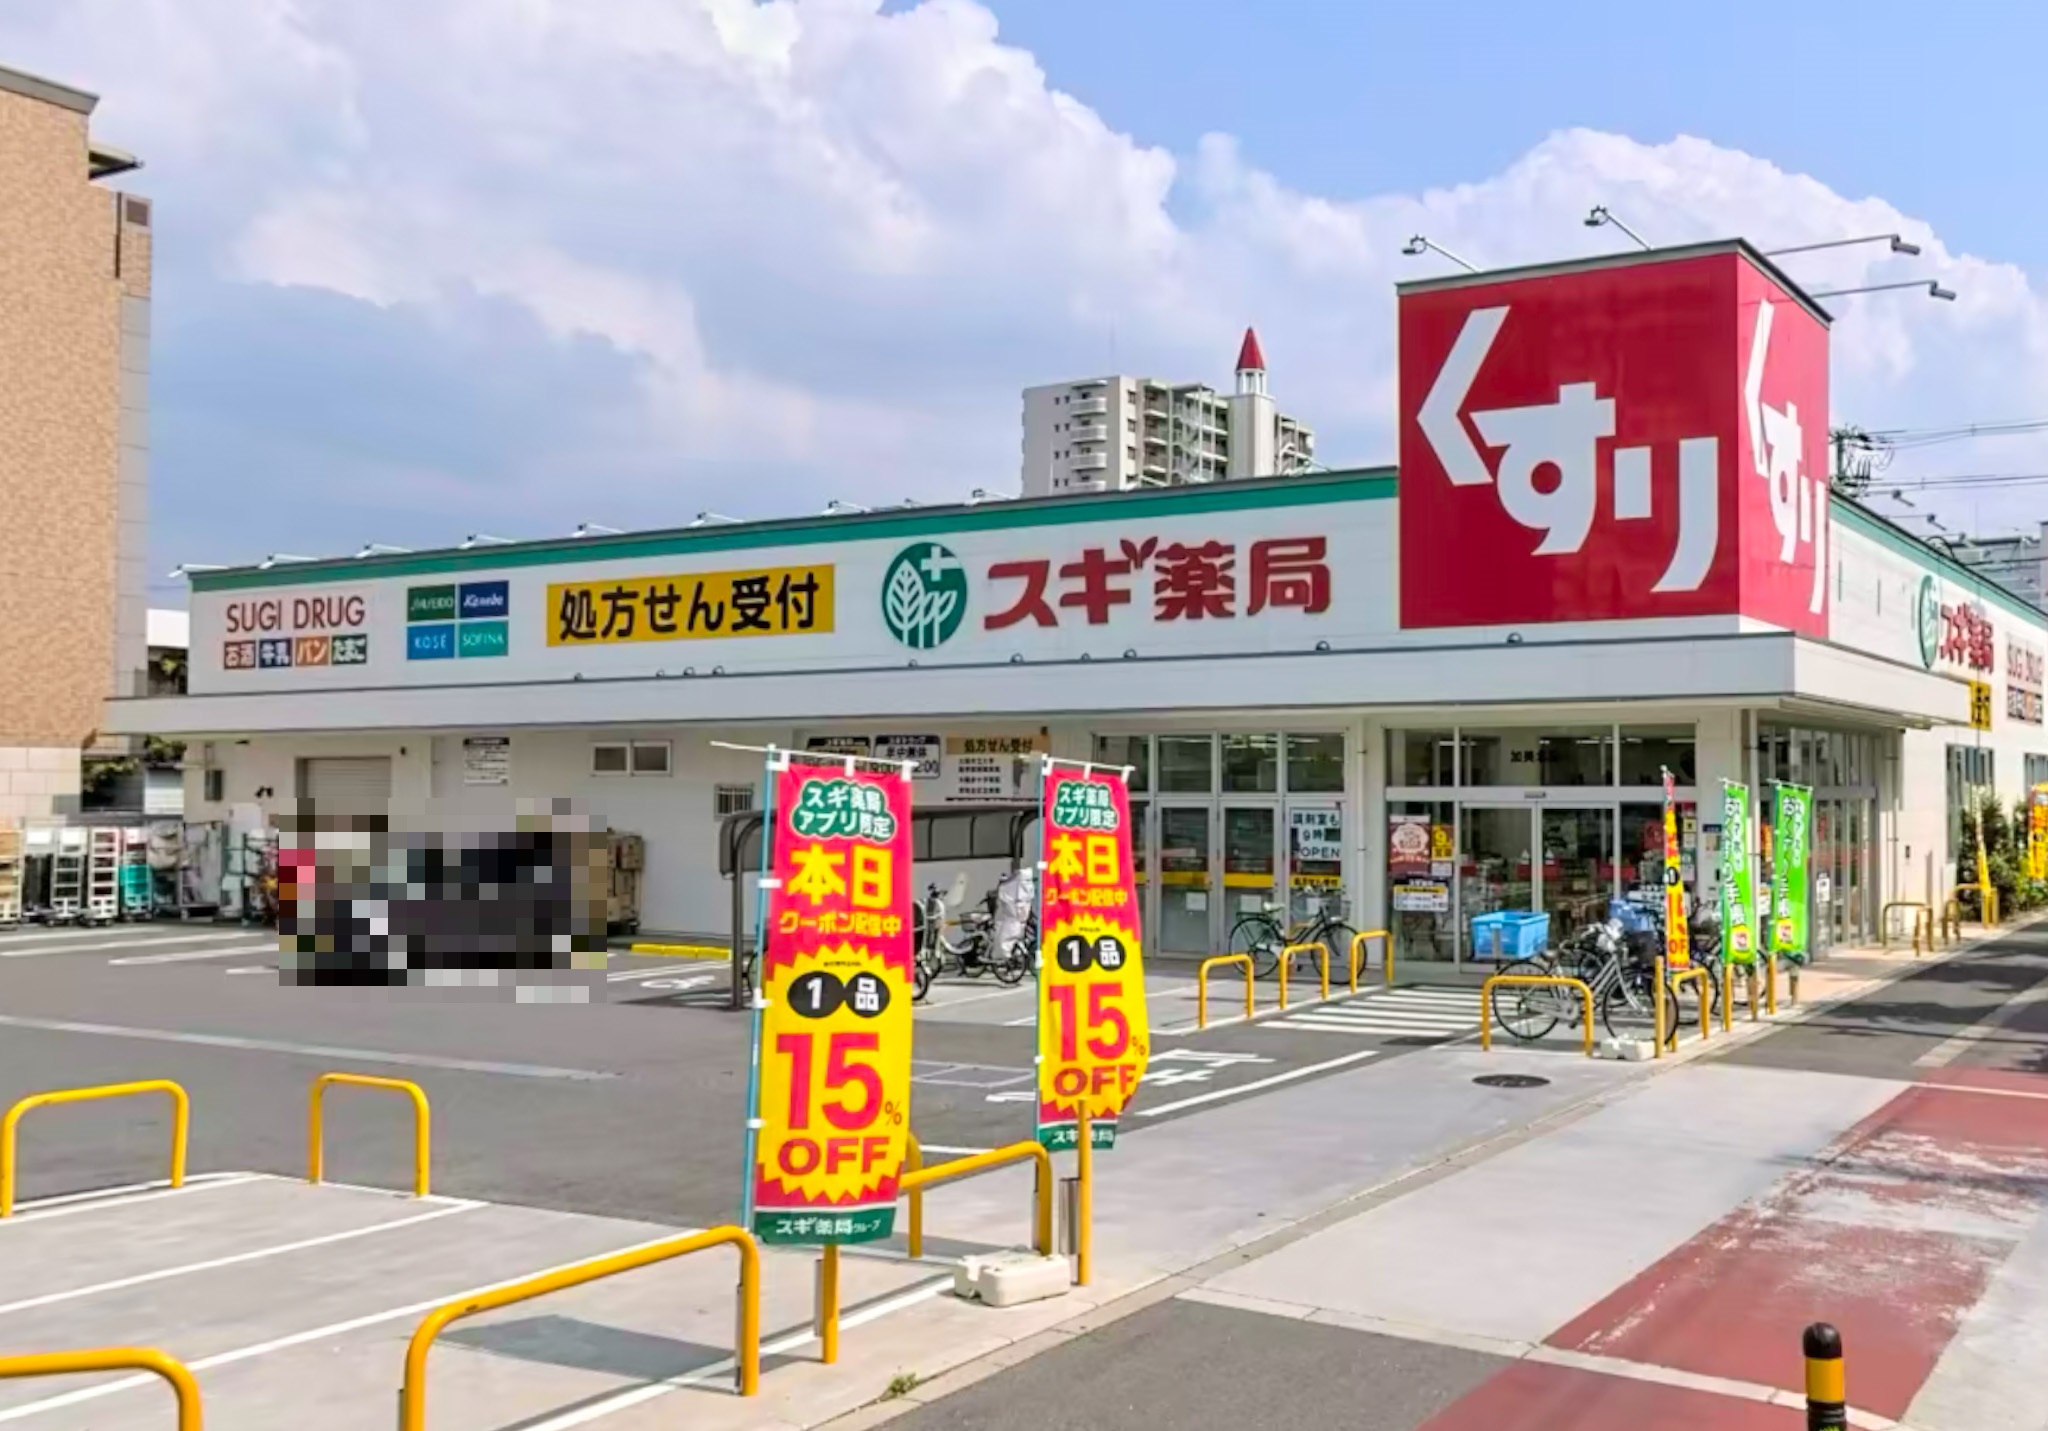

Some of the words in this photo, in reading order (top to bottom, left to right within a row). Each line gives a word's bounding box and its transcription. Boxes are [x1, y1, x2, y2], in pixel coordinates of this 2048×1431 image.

[1417, 305, 1719, 593] くすり
[1744, 298, 1826, 615] くすり
[984, 536, 1332, 632] スギ薬局
[226, 599, 283, 633] SUGI
[293, 595, 366, 630] DRUG
[558, 571, 819, 640] 処方せん受付
[297, 638, 328, 664] パン
[463, 632, 505, 647] SOFINA
[964, 738, 1033, 753] 処方せん受付
[806, 786, 882, 814] スギ薬局
[798, 811, 892, 838] アプリ限定
[1302, 829, 1323, 843] 9時
[1048, 833, 1120, 884] 本日
[1301, 846, 1340, 858] OPEN
[787, 843, 893, 909] 本日
[1053, 1064, 1137, 1097] OFF
[778, 1136, 890, 1177] OFF
